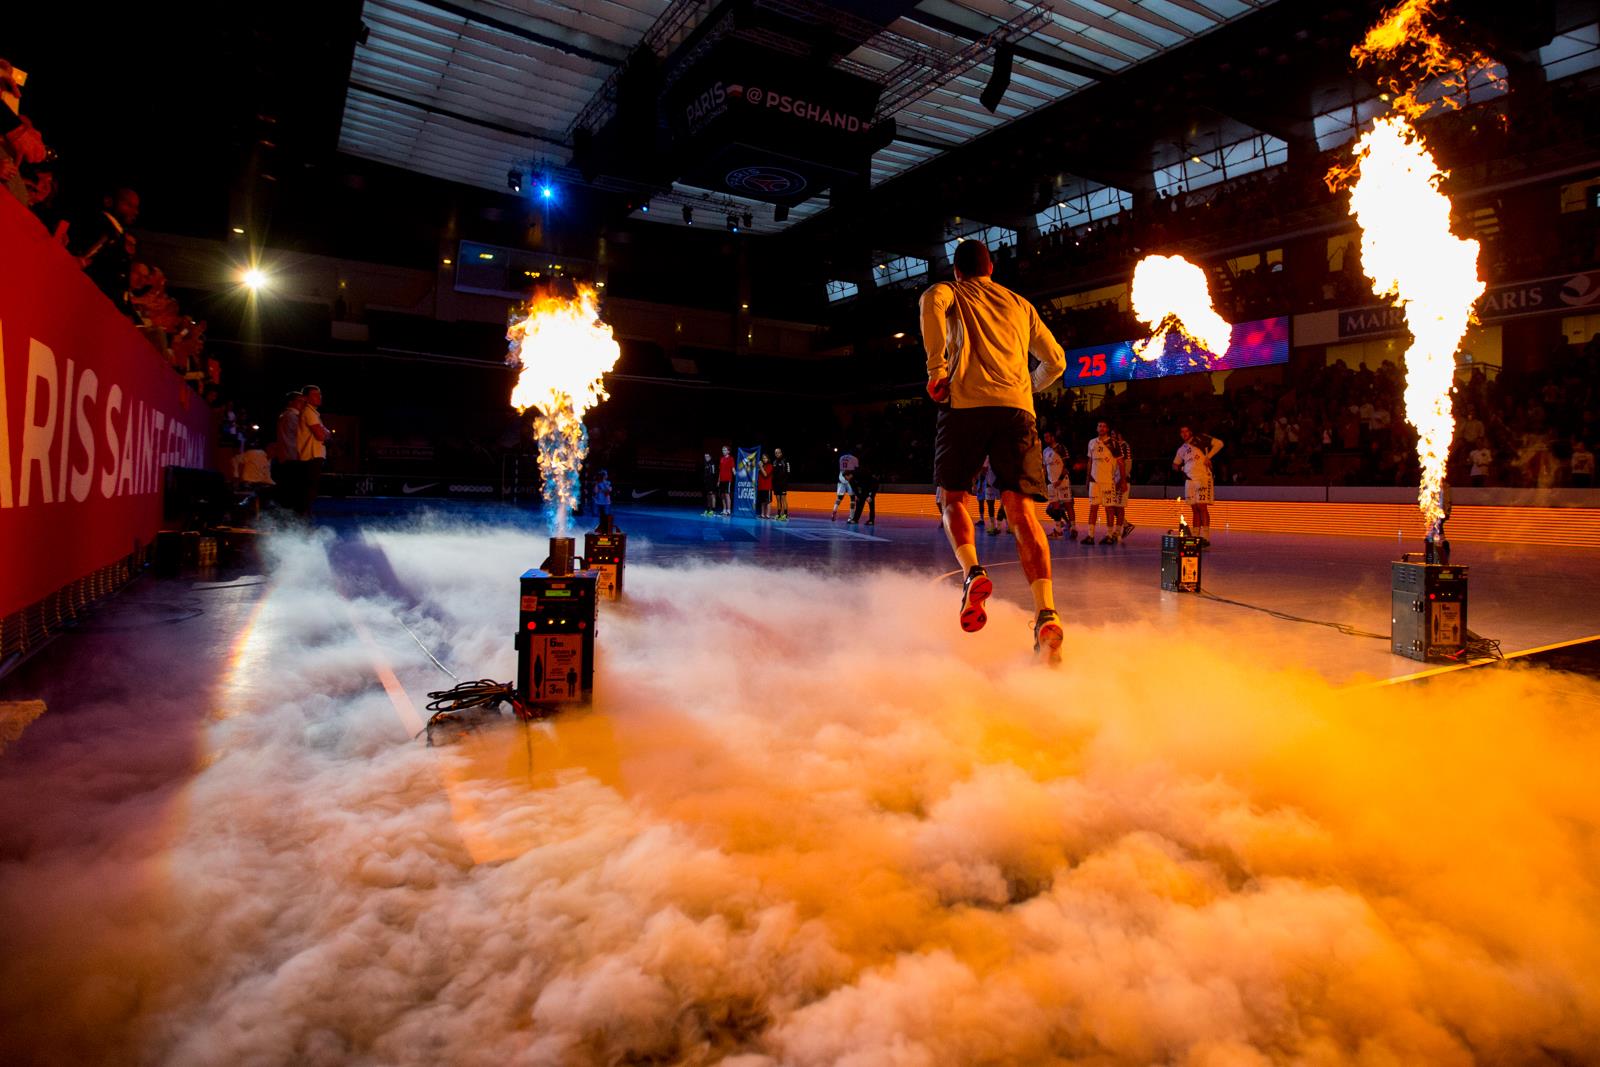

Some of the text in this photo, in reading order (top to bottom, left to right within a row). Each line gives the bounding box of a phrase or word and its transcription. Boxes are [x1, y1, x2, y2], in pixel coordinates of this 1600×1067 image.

[686, 81, 726, 128] PARIS
[1482, 287, 1543, 313] ARIS
[1078, 354, 1107, 378] 25
[549, 684, 563, 694] 3m
